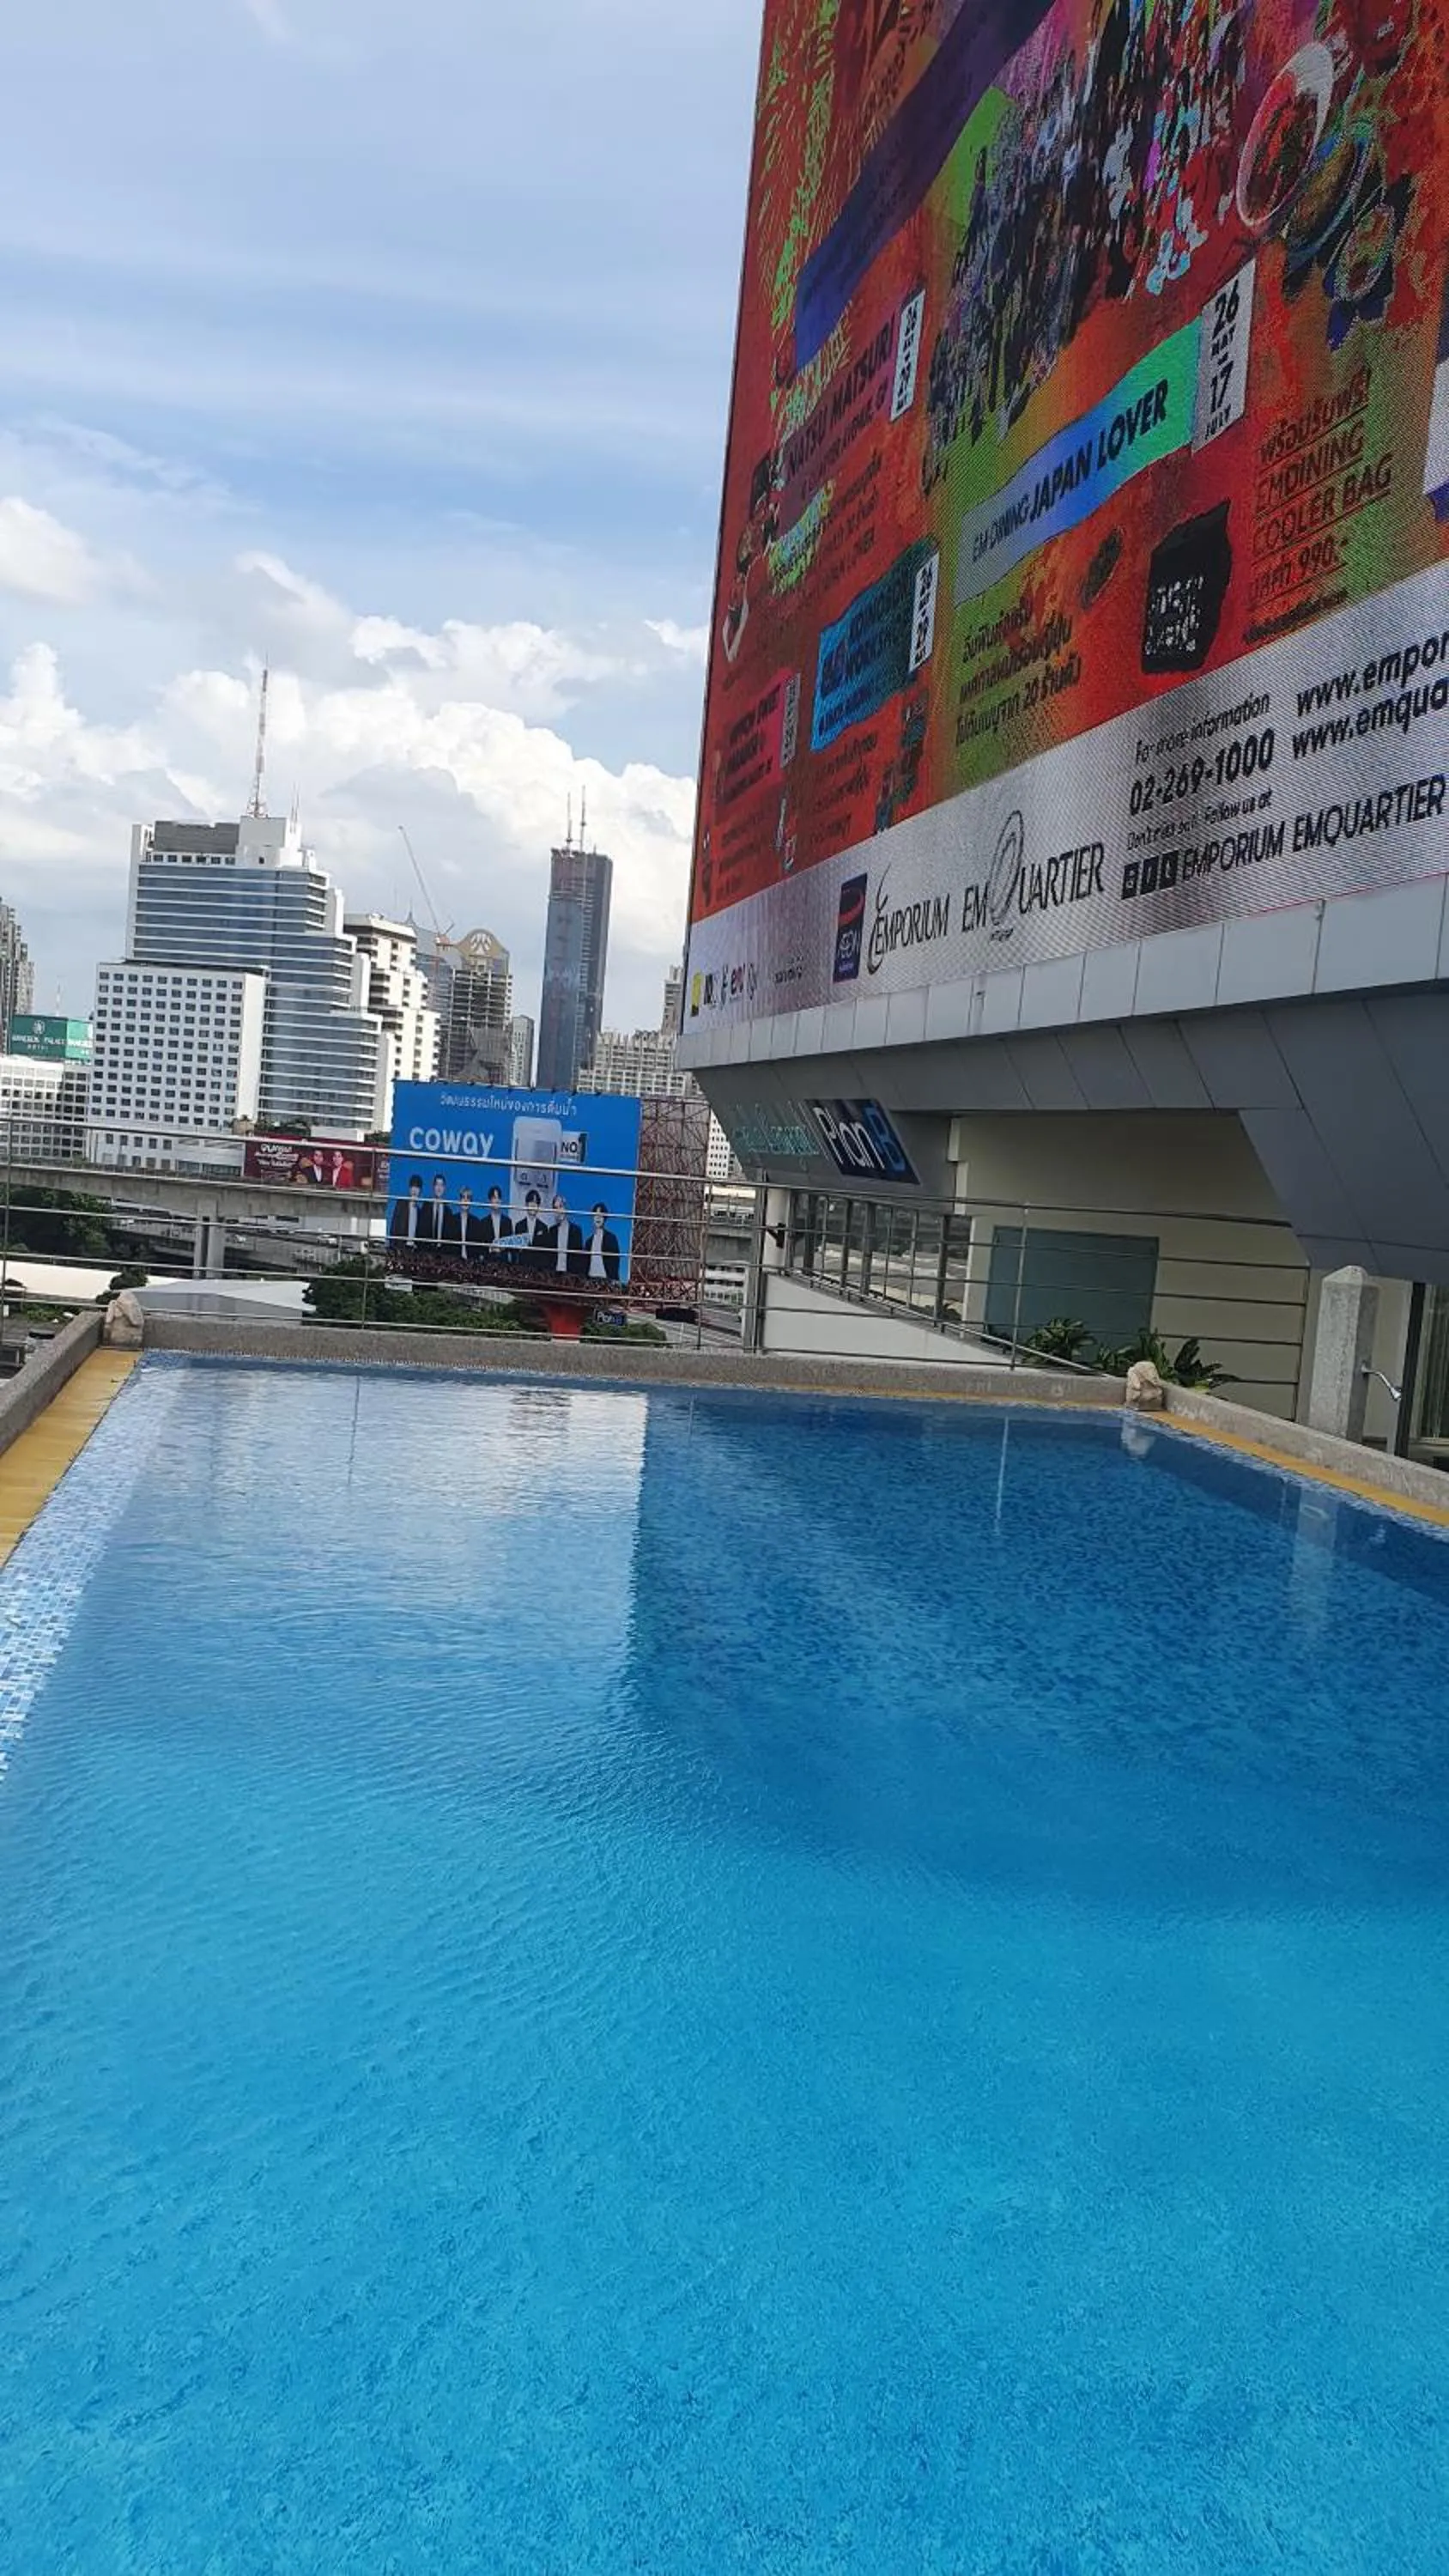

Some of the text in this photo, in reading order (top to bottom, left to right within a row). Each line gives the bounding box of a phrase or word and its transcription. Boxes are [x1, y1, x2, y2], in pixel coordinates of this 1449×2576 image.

[1212, 279, 1240, 340] 26
[830, 309, 895, 422] MATSURI
[1210, 361, 1234, 413] 17
[1030, 439, 1093, 523] JAPAN
[1096, 378, 1168, 471] LOVER
[1205, 404, 1231, 440] JULY
[1252, 453, 1393, 557] COOLER BAG
[1255, 420, 1365, 514] EMDINING
[1190, 691, 1270, 743] information
[1130, 728, 1275, 817] 02-269-1000
[1181, 773, 1446, 882] EMPORIUM EMQUARTIER
[869, 886, 951, 975] EMPORIUM
